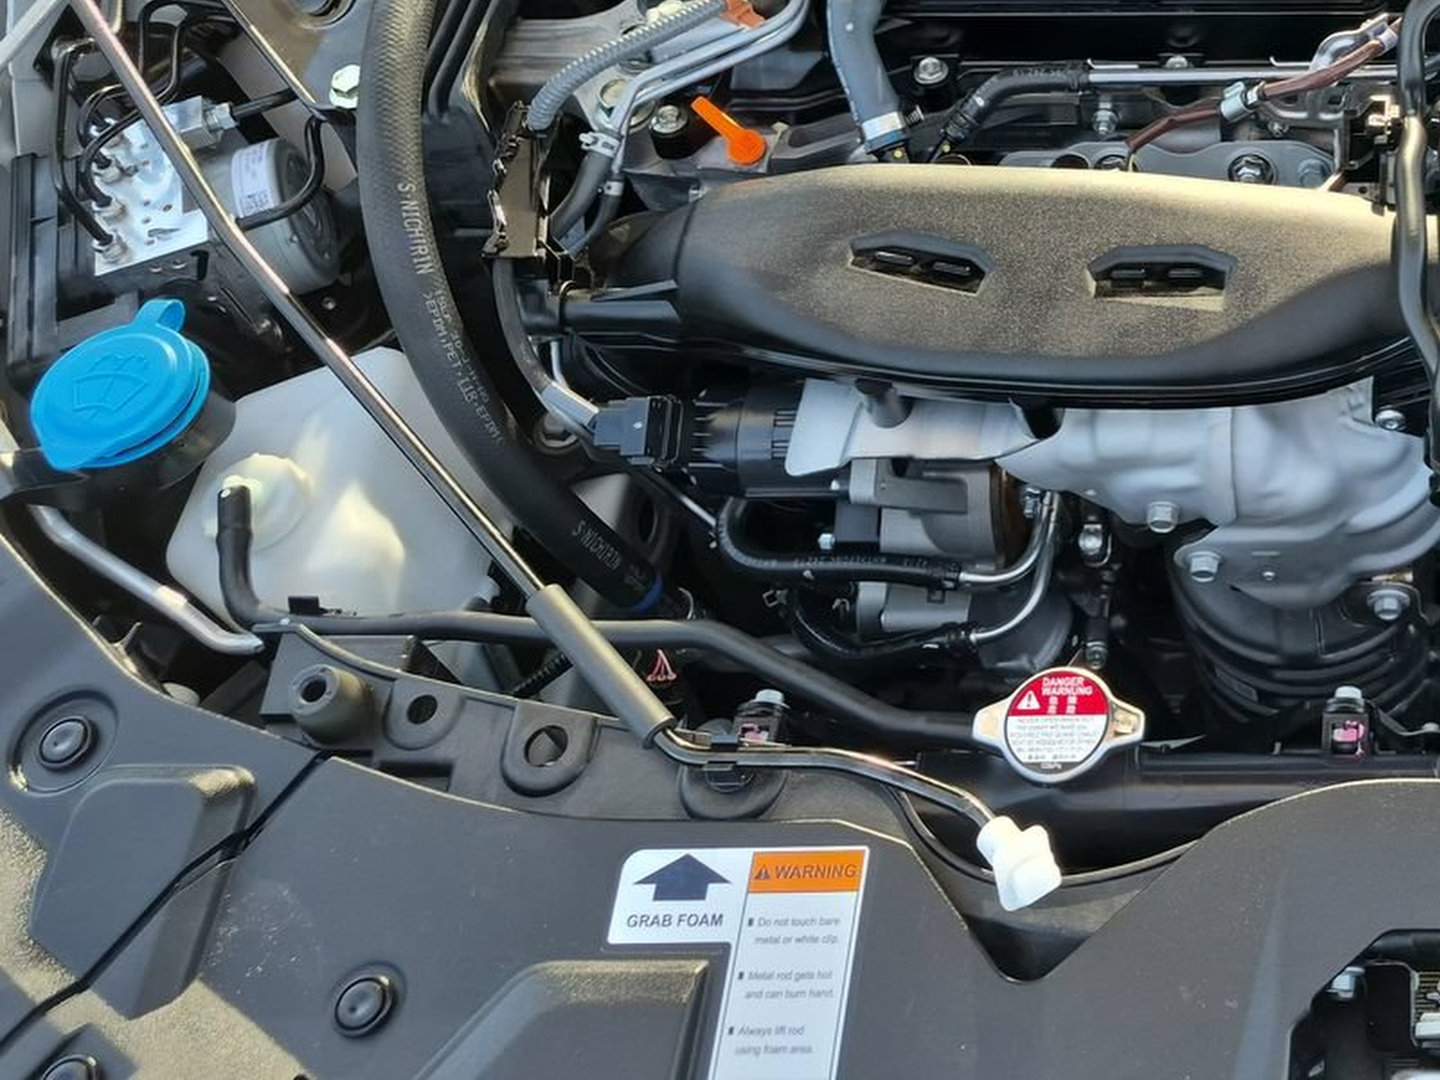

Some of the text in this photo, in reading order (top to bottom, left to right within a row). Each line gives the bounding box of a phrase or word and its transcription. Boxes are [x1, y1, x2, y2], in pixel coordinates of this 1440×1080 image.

[1042, 677, 1085, 686] DANGER
[775, 864, 858, 879] WARNING
[626, 913, 724, 928] GRAB FOAM
[757, 917, 772, 927] Do
[773, 917, 789, 927] not
